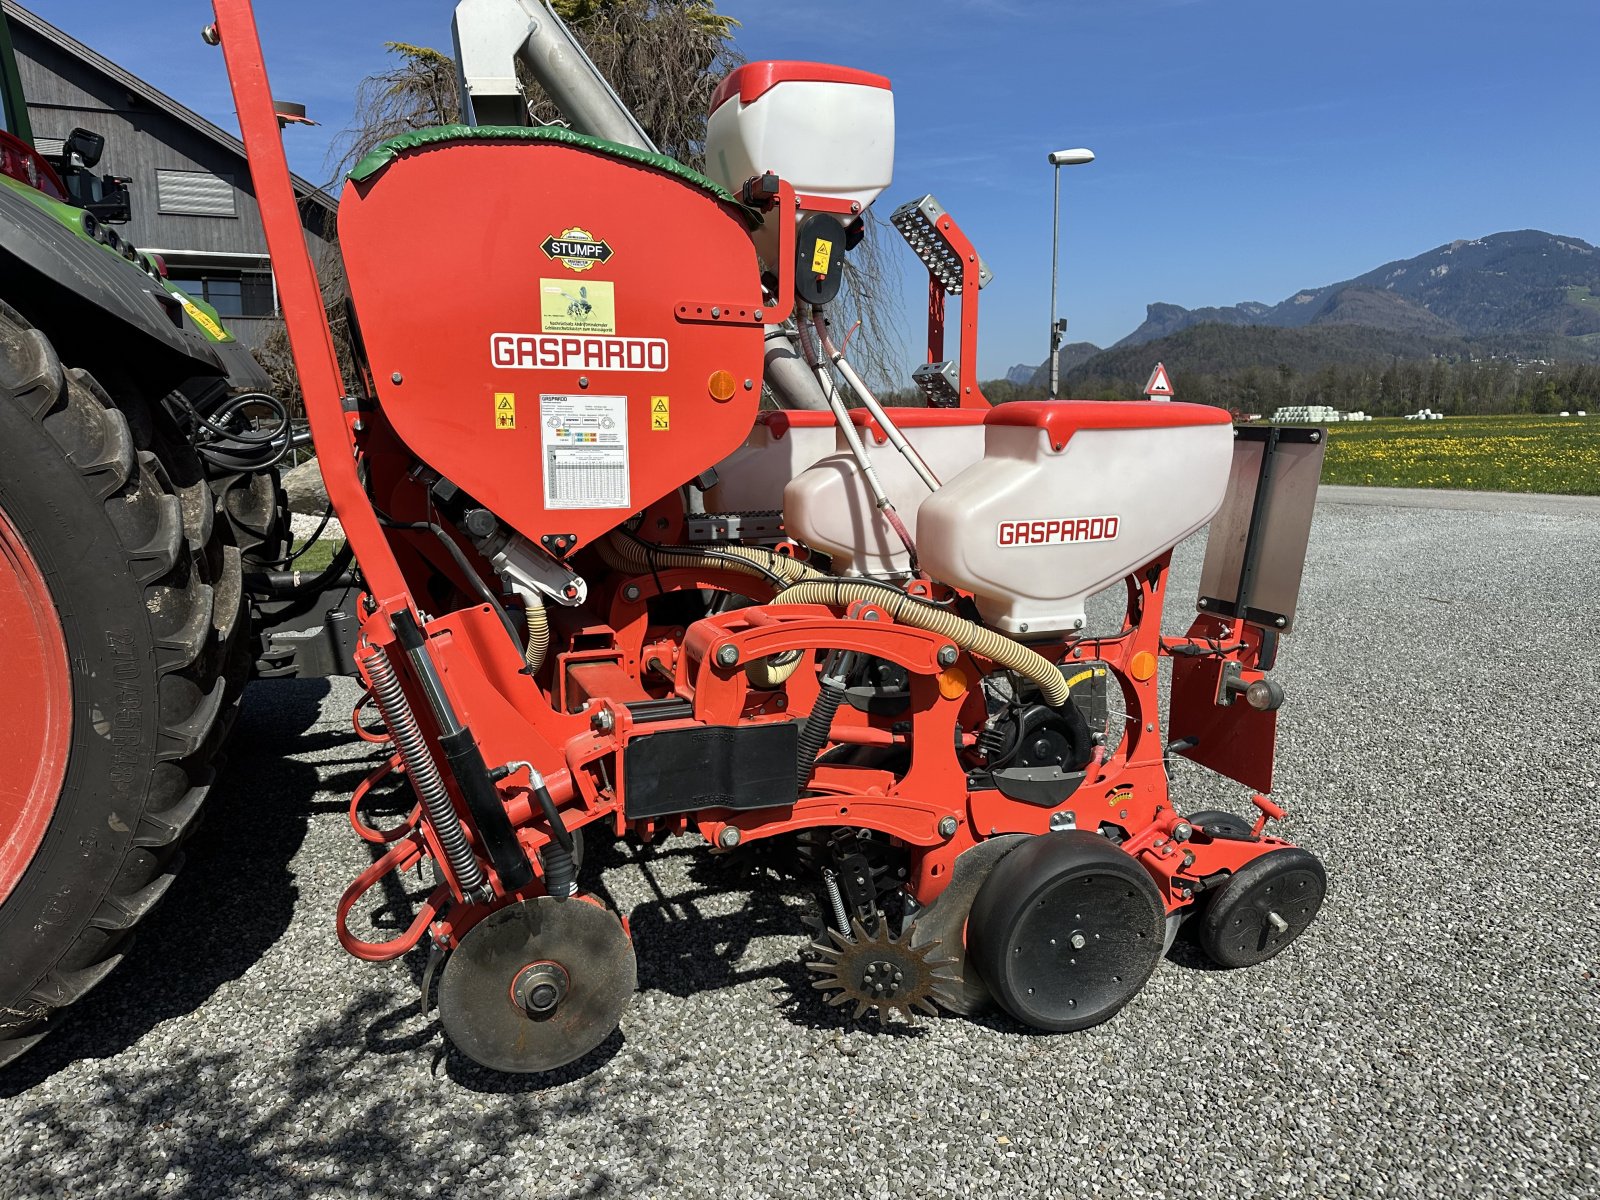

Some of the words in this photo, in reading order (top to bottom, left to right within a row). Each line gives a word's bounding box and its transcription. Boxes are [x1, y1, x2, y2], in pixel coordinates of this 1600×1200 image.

[551, 242, 603, 257] STUMPF
[494, 336, 666, 369] GASPARDO
[1000, 517, 1119, 545] GASPARDO
